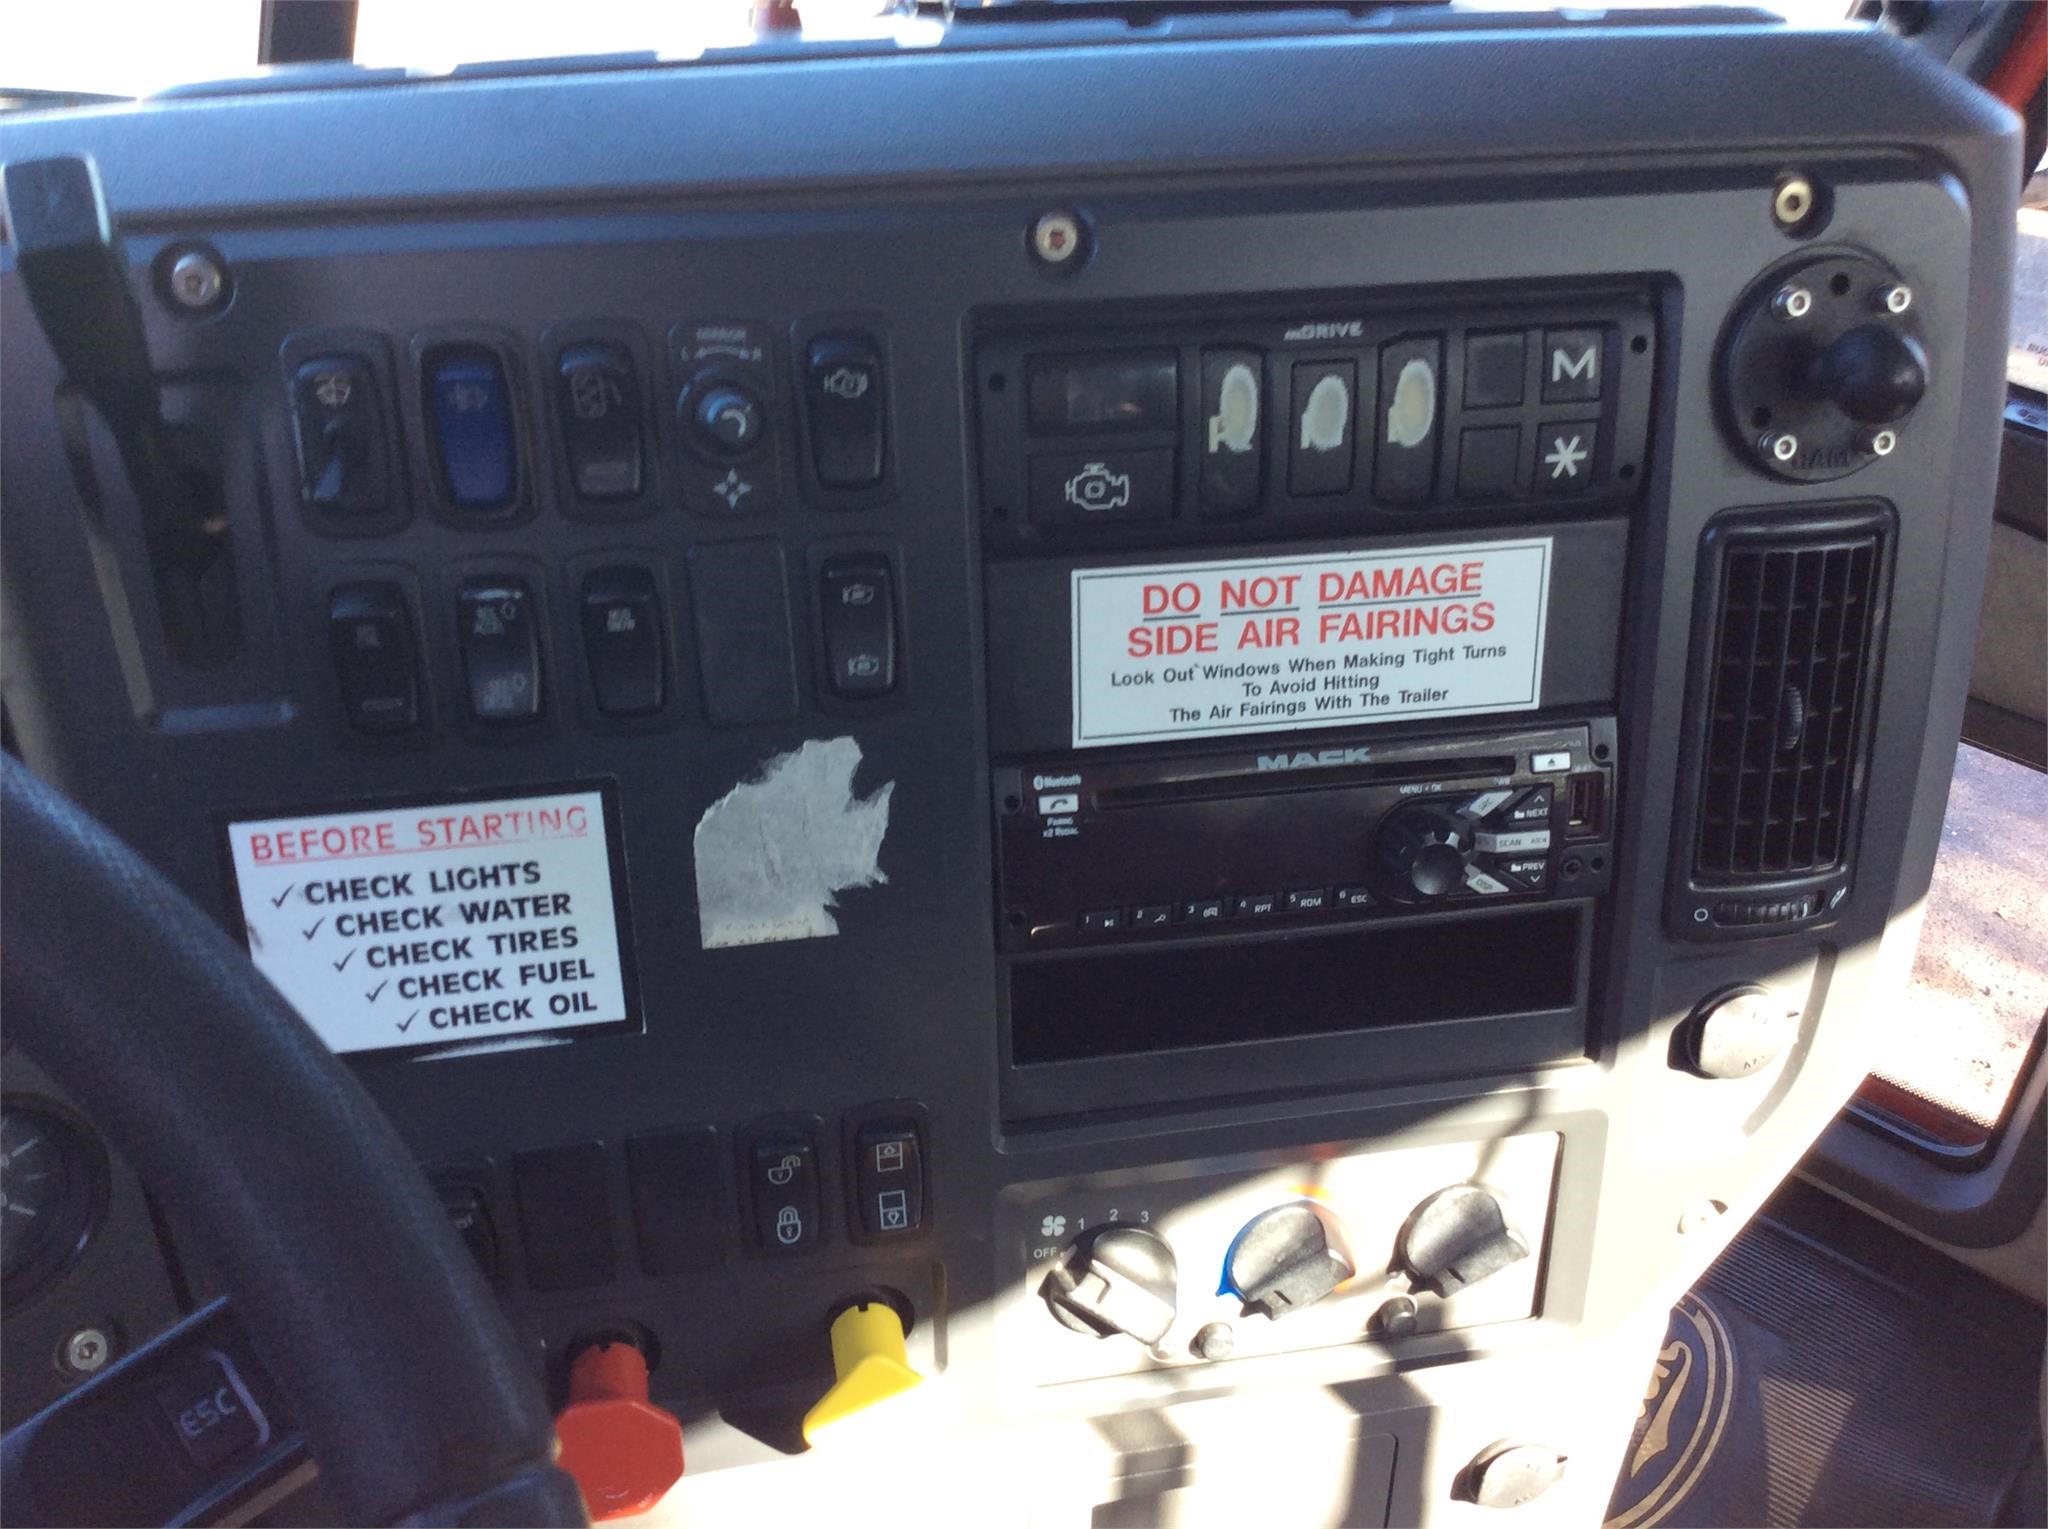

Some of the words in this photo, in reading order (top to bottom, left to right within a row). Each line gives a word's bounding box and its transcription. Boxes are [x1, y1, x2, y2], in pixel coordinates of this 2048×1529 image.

[1552, 346, 1596, 382] M
[1142, 581, 1201, 615] DO
[1220, 575, 1302, 610] NOT
[1318, 561, 1484, 603] DAMAGE
[1127, 622, 1219, 658] SIDE
[1236, 616, 1301, 650] AIR
[1319, 601, 1496, 644] FAIRINGS
[1111, 671, 1154, 687] Look
[1163, 667, 1195, 683] Out
[1202, 663, 1280, 680] Windows
[1288, 656, 1336, 673] When
[1343, 652, 1405, 669] Making
[1413, 647, 1456, 665] Tight
[1462, 644, 1507, 660] Turns
[1242, 682, 1261, 697] To
[1269, 677, 1316, 694] Avoid
[1323, 674, 1380, 691] Hitting
[1170, 707, 1201, 722] The
[1209, 705, 1232, 720] Air
[1239, 699, 1306, 717] Fairings
[1314, 695, 1352, 711] With
[1360, 691, 1390, 707] The
[1398, 688, 1449, 704] Trailer
[1256, 747, 1371, 769] MACK
[1525, 807, 1549, 819] NEXT
[250, 822, 397, 862] BEFORE
[417, 804, 589, 848] STARTING
[1499, 838, 1522, 848] SCAN
[304, 873, 413, 905] CHECK
[429, 860, 542, 893] LIGHTS
[1522, 862, 1546, 872] PREV
[335, 904, 443, 938] CHECK
[459, 892, 572, 926] WATER
[1254, 903, 1272, 913] RPT
[365, 936, 473, 970] CHECK
[487, 925, 580, 957] TIRES
[397, 967, 504, 1000] CHECK
[519, 957, 596, 987] FUEL
[428, 998, 534, 1031] CHECK
[548, 990, 598, 1018] OIL
[1078, 1217, 1086, 1231] 1
[1109, 1208, 1119, 1222] 2
[1140, 1209, 1150, 1223] 3
[1032, 1246, 1058, 1260] OFF
[180, 1386, 237, 1437] ESC
